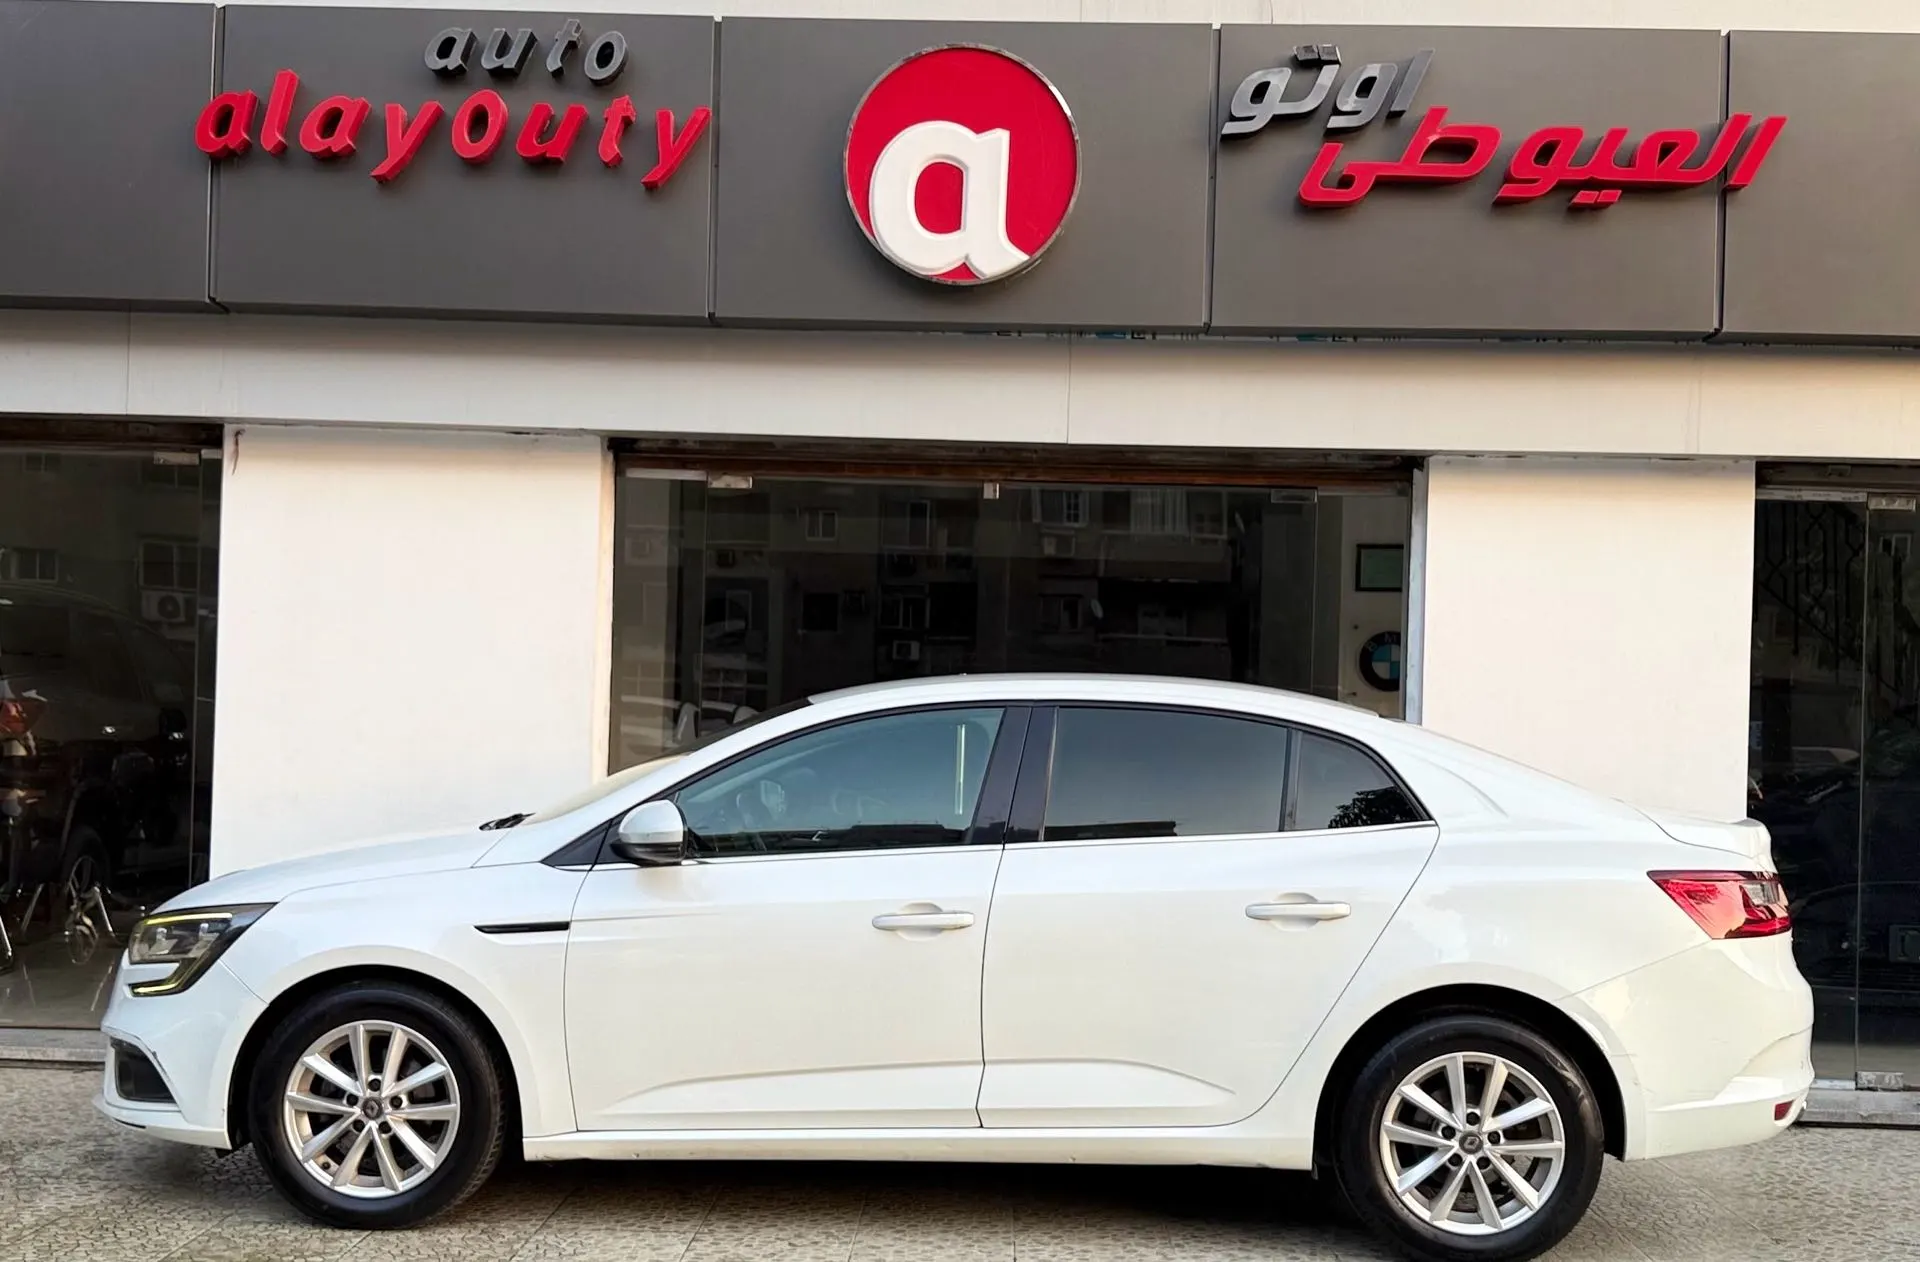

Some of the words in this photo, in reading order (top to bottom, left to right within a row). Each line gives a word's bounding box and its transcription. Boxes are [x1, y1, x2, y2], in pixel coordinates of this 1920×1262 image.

[425, 19, 628, 83] auto
[1221, 44, 1435, 138] اوتو
[195, 69, 711, 188] alayouty
[868, 120, 1030, 279] a
